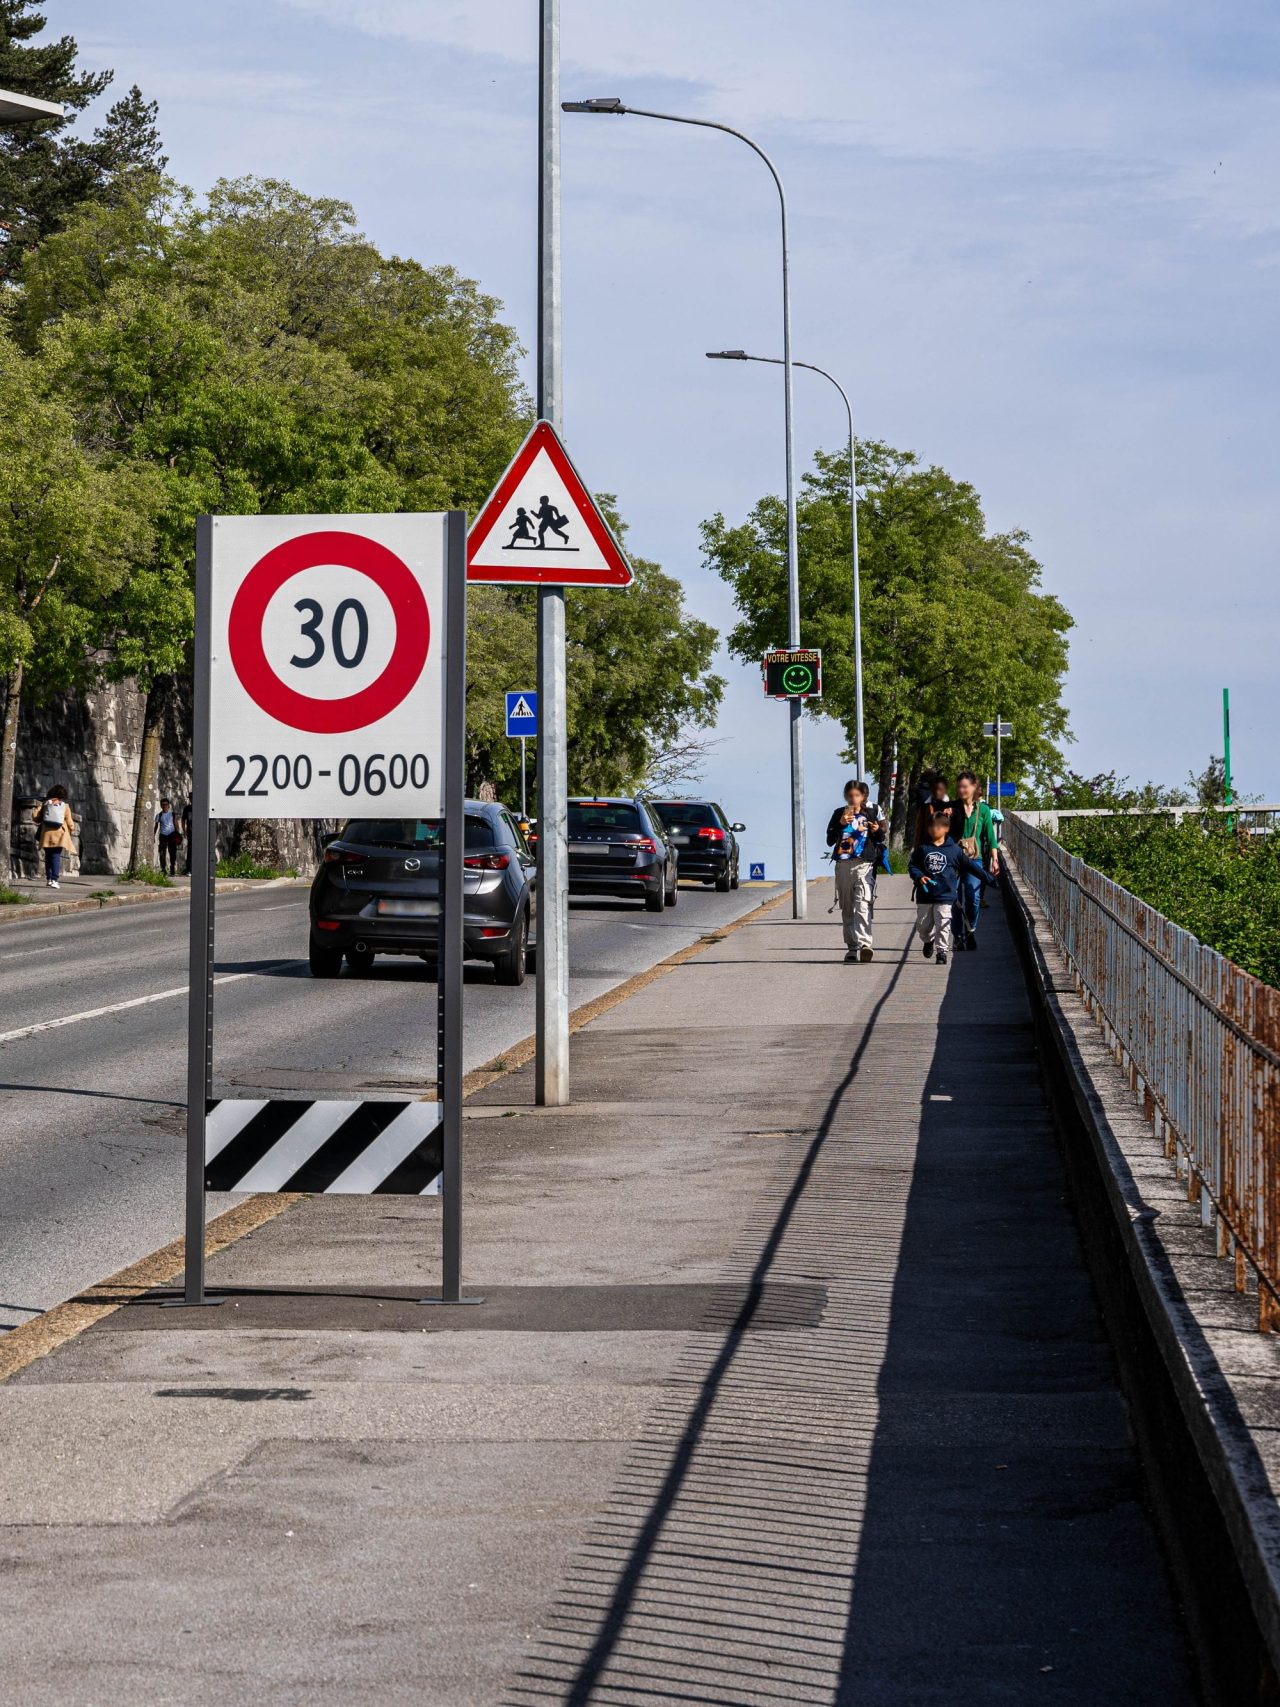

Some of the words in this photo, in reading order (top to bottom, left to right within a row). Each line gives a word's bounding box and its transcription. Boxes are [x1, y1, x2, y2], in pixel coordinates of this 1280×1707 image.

[290, 598, 368, 669] 30
[768, 653, 790, 663] VOTRE
[791, 652, 817, 663] VITESSE
